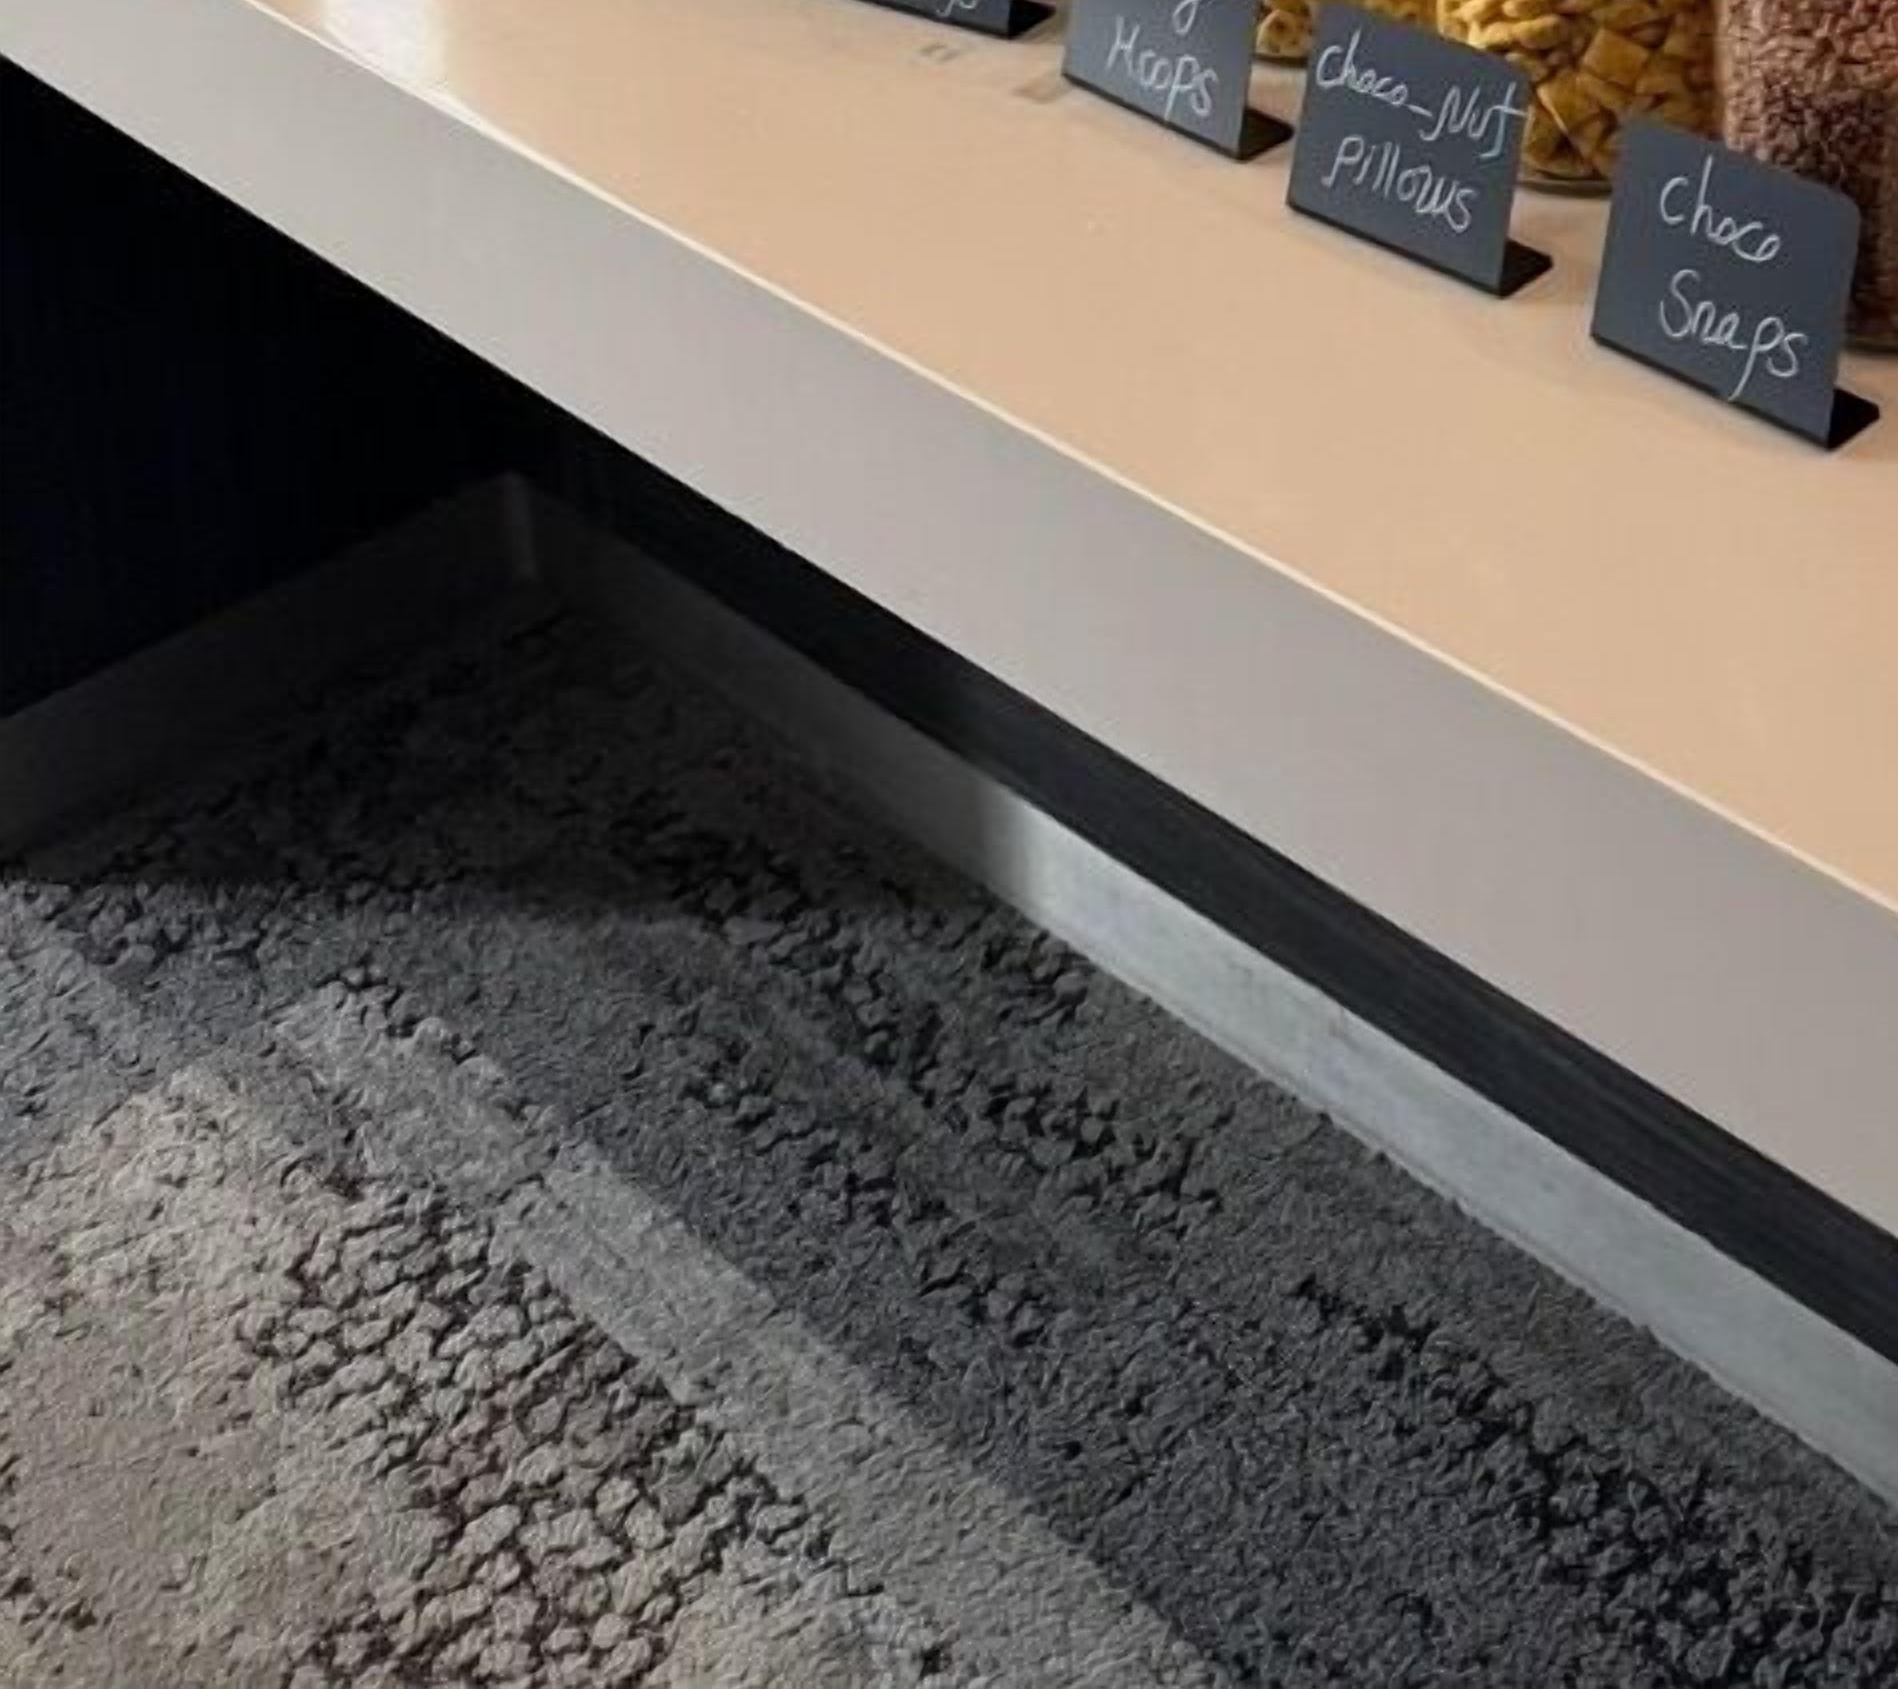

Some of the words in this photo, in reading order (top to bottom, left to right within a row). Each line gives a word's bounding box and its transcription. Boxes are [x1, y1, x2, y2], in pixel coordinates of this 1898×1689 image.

[1106, 16, 1221, 120] Hoops
[1322, 134, 1477, 234] Pillows
[1660, 268, 1809, 401] Snaps
